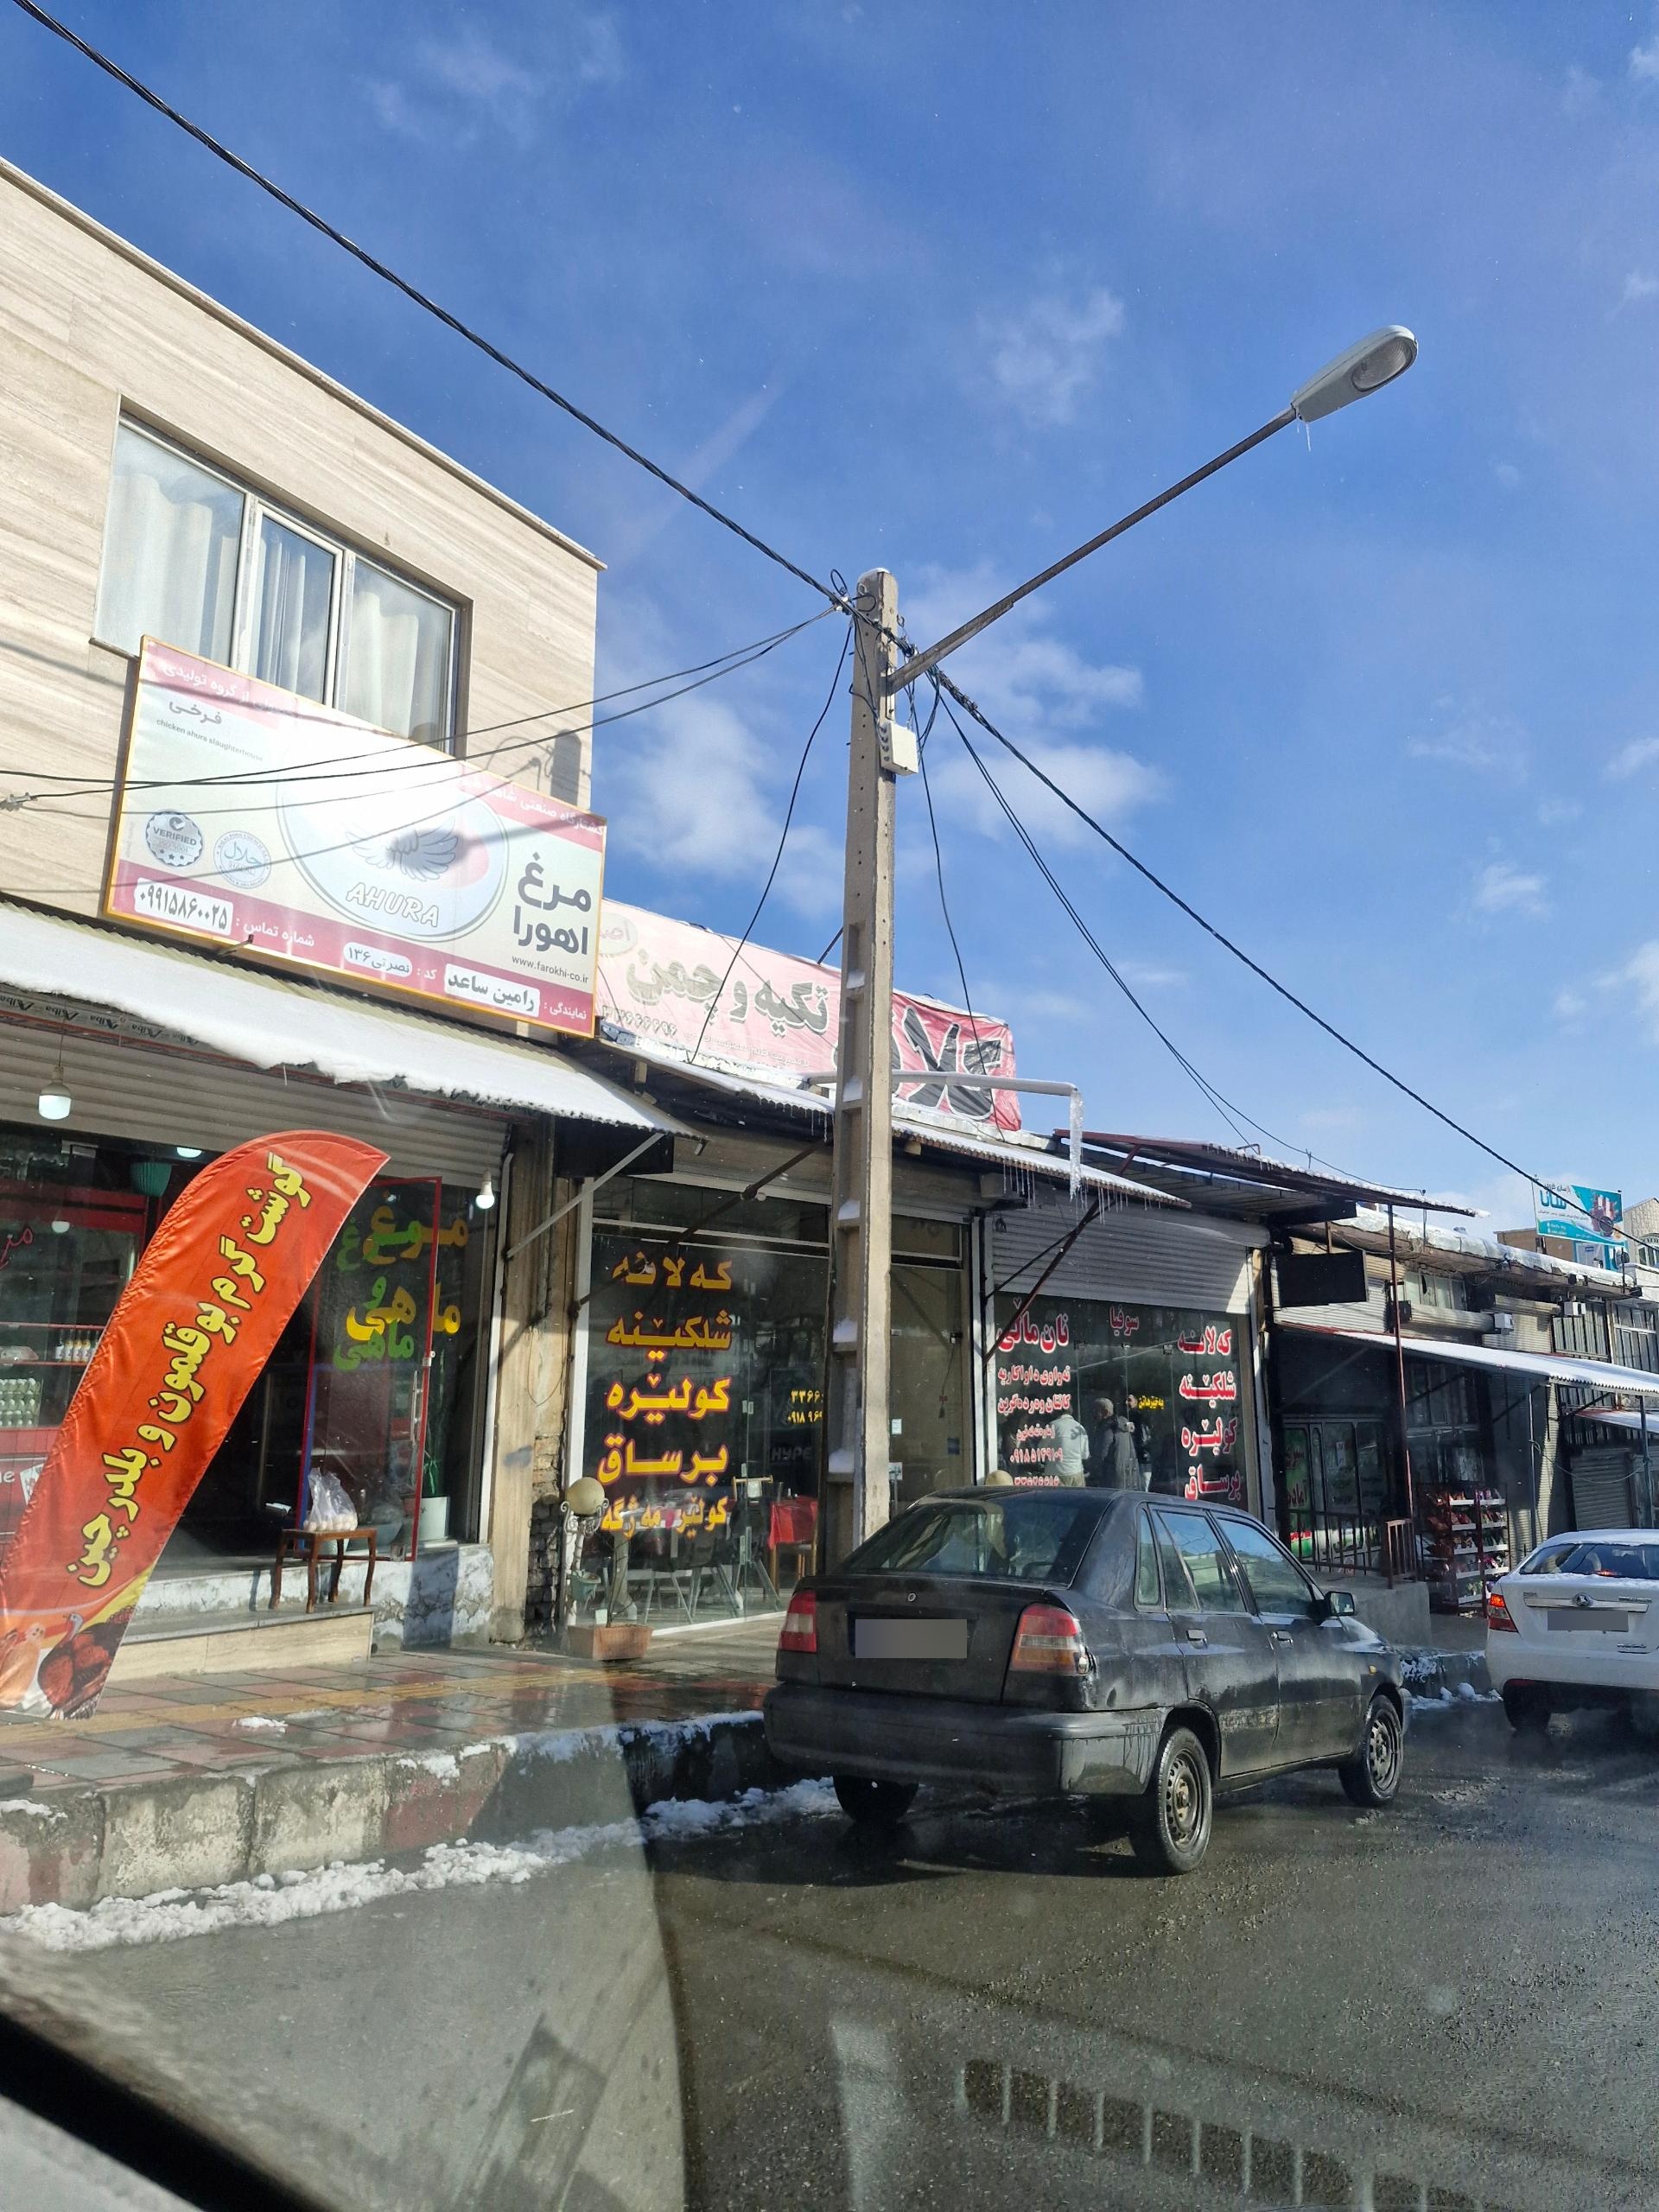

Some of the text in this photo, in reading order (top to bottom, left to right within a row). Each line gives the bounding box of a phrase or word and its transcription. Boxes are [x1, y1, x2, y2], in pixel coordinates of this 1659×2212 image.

[162, 662, 208, 687] تولیدی
[211, 679, 237, 697] گروه
[168, 700, 222, 725] فرخی
[156, 718, 264, 762] chicken ahura slaughterhouse
[520, 798, 557, 817] صنعتی
[153, 826, 197, 846] VERIFIED
[224, 841, 264, 865] حلال
[518, 851, 592, 912] مرغ
[346, 881, 440, 928] AHURA
[281, 929, 315, 947] شماره
[513, 905, 588, 956] اهورا
[448, 974, 488, 995] ساعد
[512, 955, 588, 984] www.farokhi-co.ir
[626, 948, 724, 1026] چمن
[493, 988, 535, 1012] رامین
[729, 980, 748, 1024] و
[754, 980, 830, 1037] تکیه
[345, 1282, 461, 1342] ماهی
[1109, 1305, 1140, 1337] سوفیا
[1039, 1313, 1070, 1353] نان
[65, 1151, 312, 1588] گوشت گرم بوقلمون و بلدرچین
[596, 1432, 730, 1487] برساق
[1184, 1463, 1242, 1502] برساق
